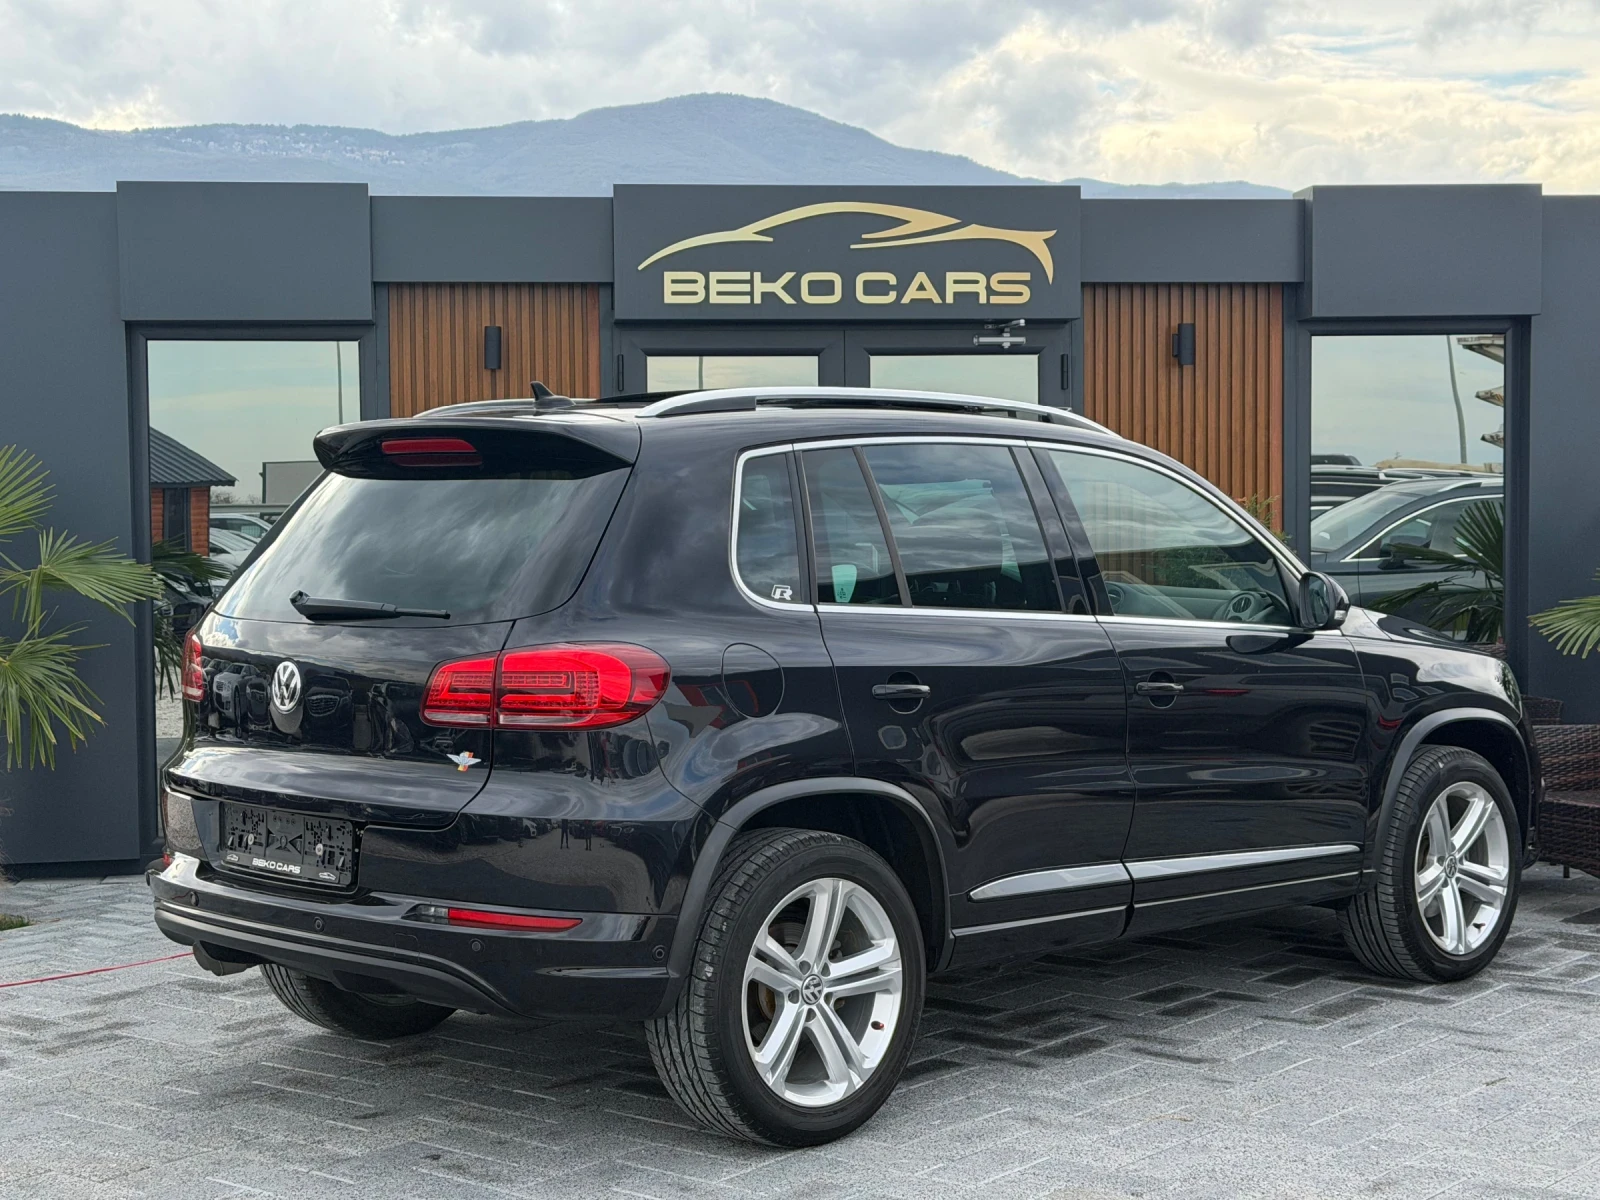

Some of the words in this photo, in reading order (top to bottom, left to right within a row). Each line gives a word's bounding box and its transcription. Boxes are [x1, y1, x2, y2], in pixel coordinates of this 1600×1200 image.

[664, 271, 842, 304] BEKO
[856, 271, 1031, 304] CARS
[771, 585, 792, 601] R
[272, 661, 301, 710] VW
[252, 857, 276, 869] BEKO
[275, 862, 301, 874] CARS
